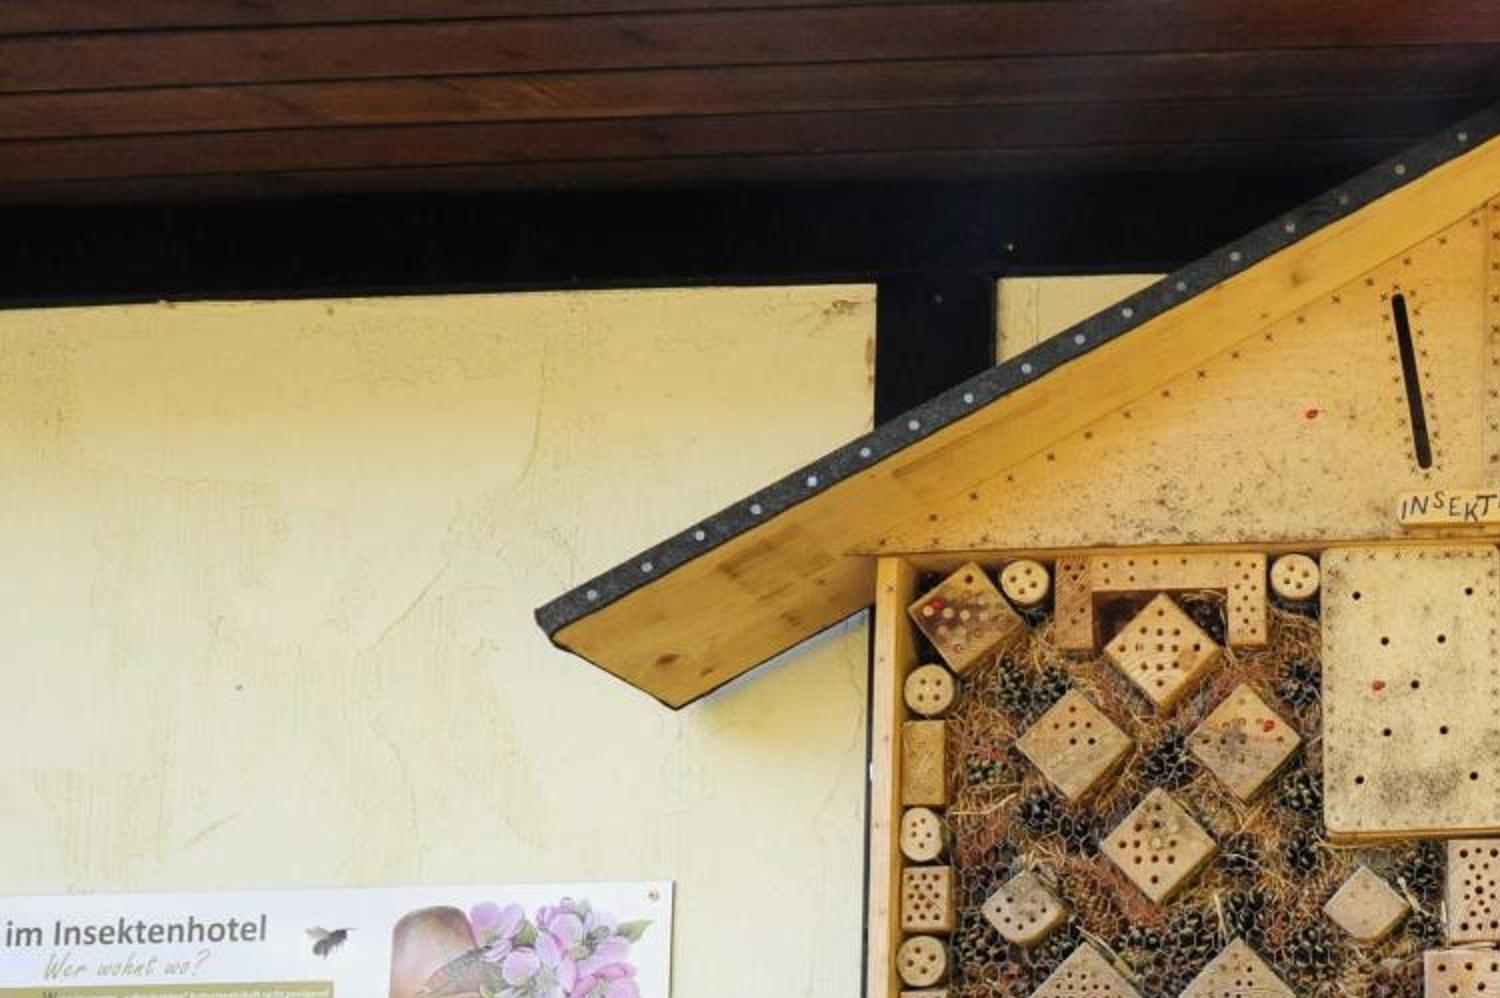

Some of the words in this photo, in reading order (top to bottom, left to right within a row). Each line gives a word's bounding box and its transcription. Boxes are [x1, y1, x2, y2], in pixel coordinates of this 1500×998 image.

[5, 921, 43, 947] im
[54, 914, 267, 946] Insektenhotel
[42, 950, 88, 980] Wer
[95, 950, 157, 978] wohnt
[162, 949, 212, 976] wo?
